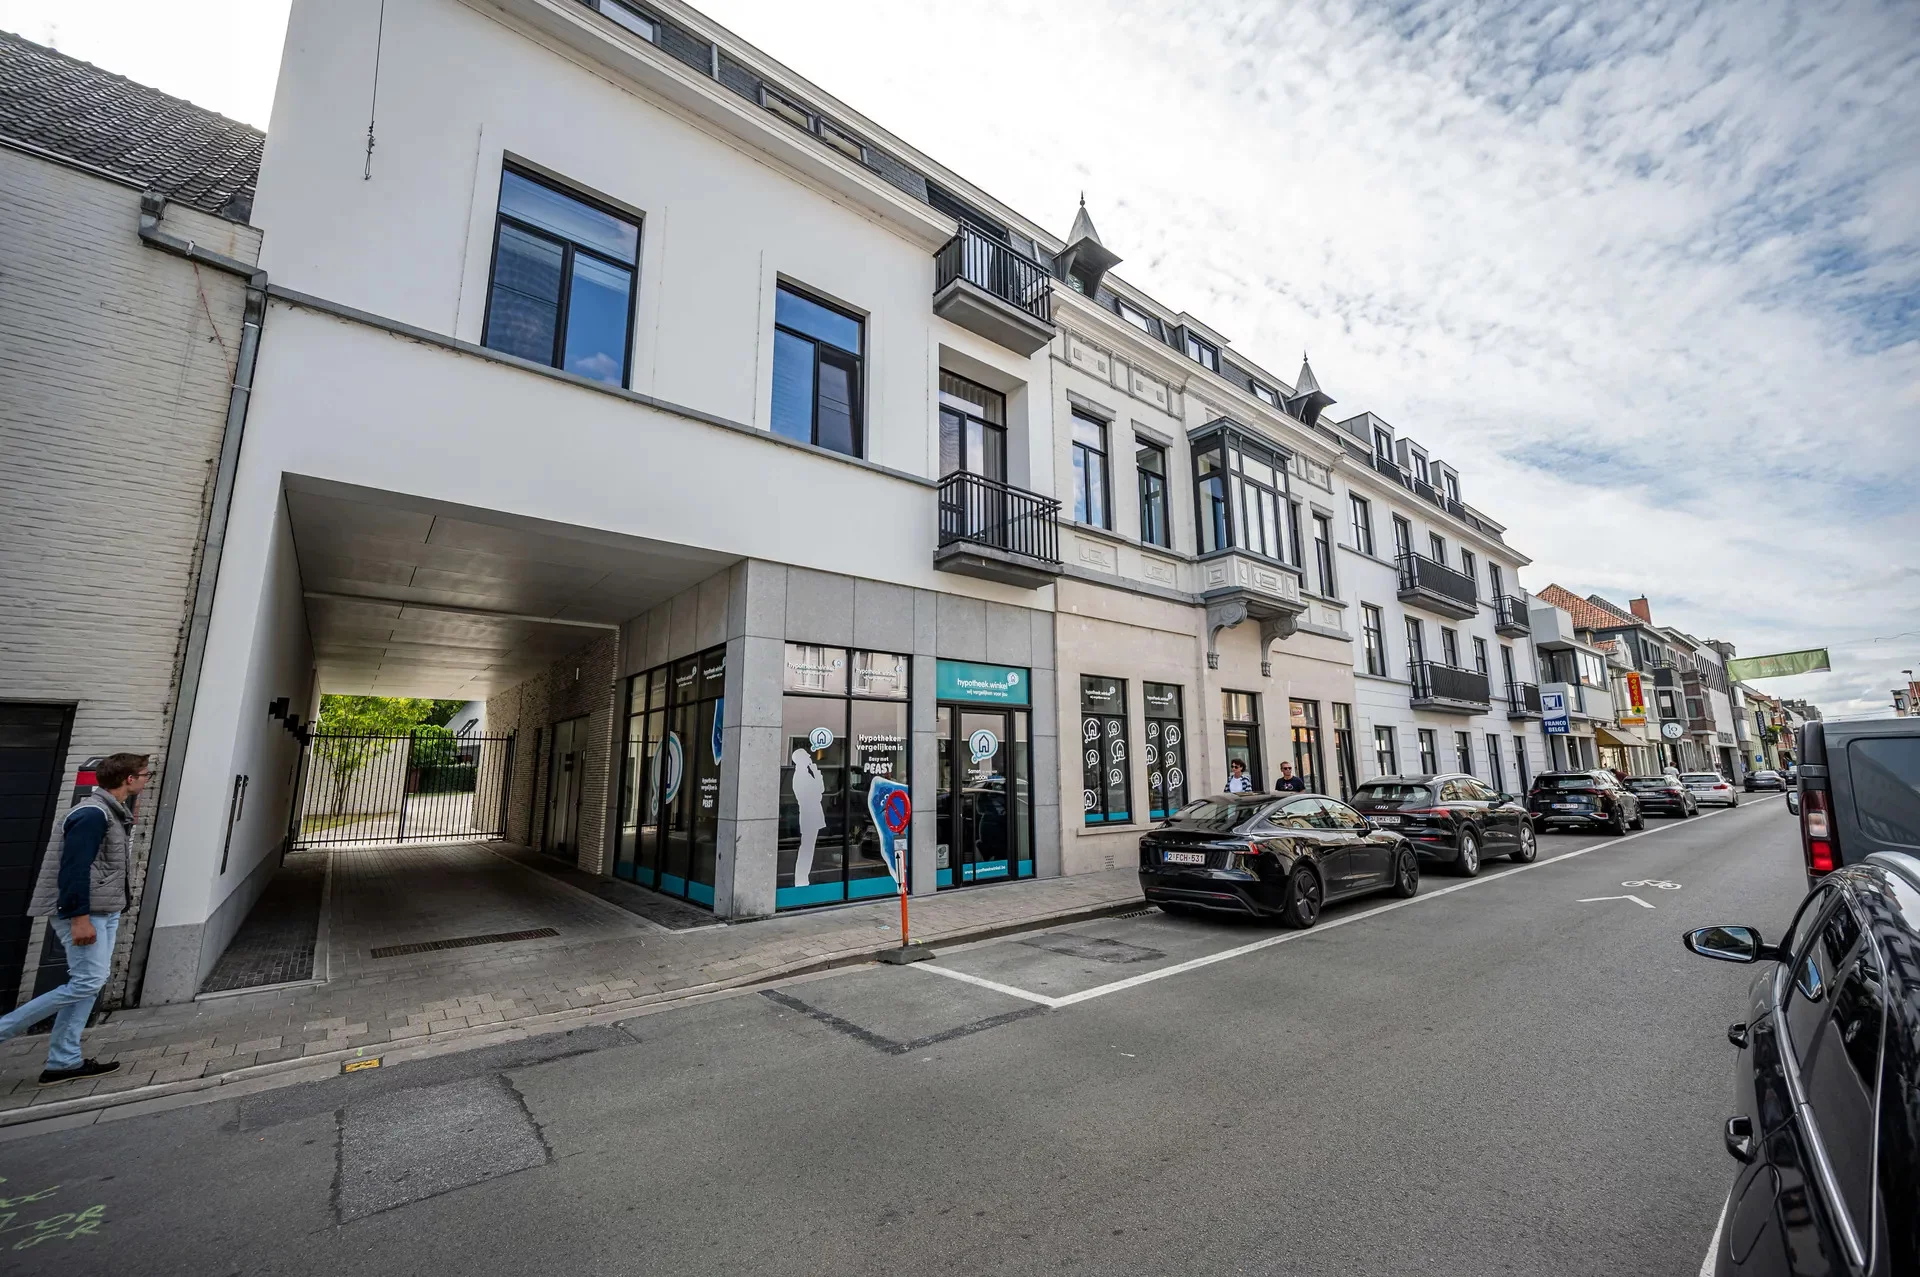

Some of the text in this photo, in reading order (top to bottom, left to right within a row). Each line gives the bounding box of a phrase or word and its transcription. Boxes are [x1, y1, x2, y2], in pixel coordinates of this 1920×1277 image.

[957, 678, 1007, 690] hypotheek.winkel
[858, 734, 902, 743] Hypotheken
[856, 743, 904, 752] vergelijken is
[863, 762, 893, 774] PEASY
